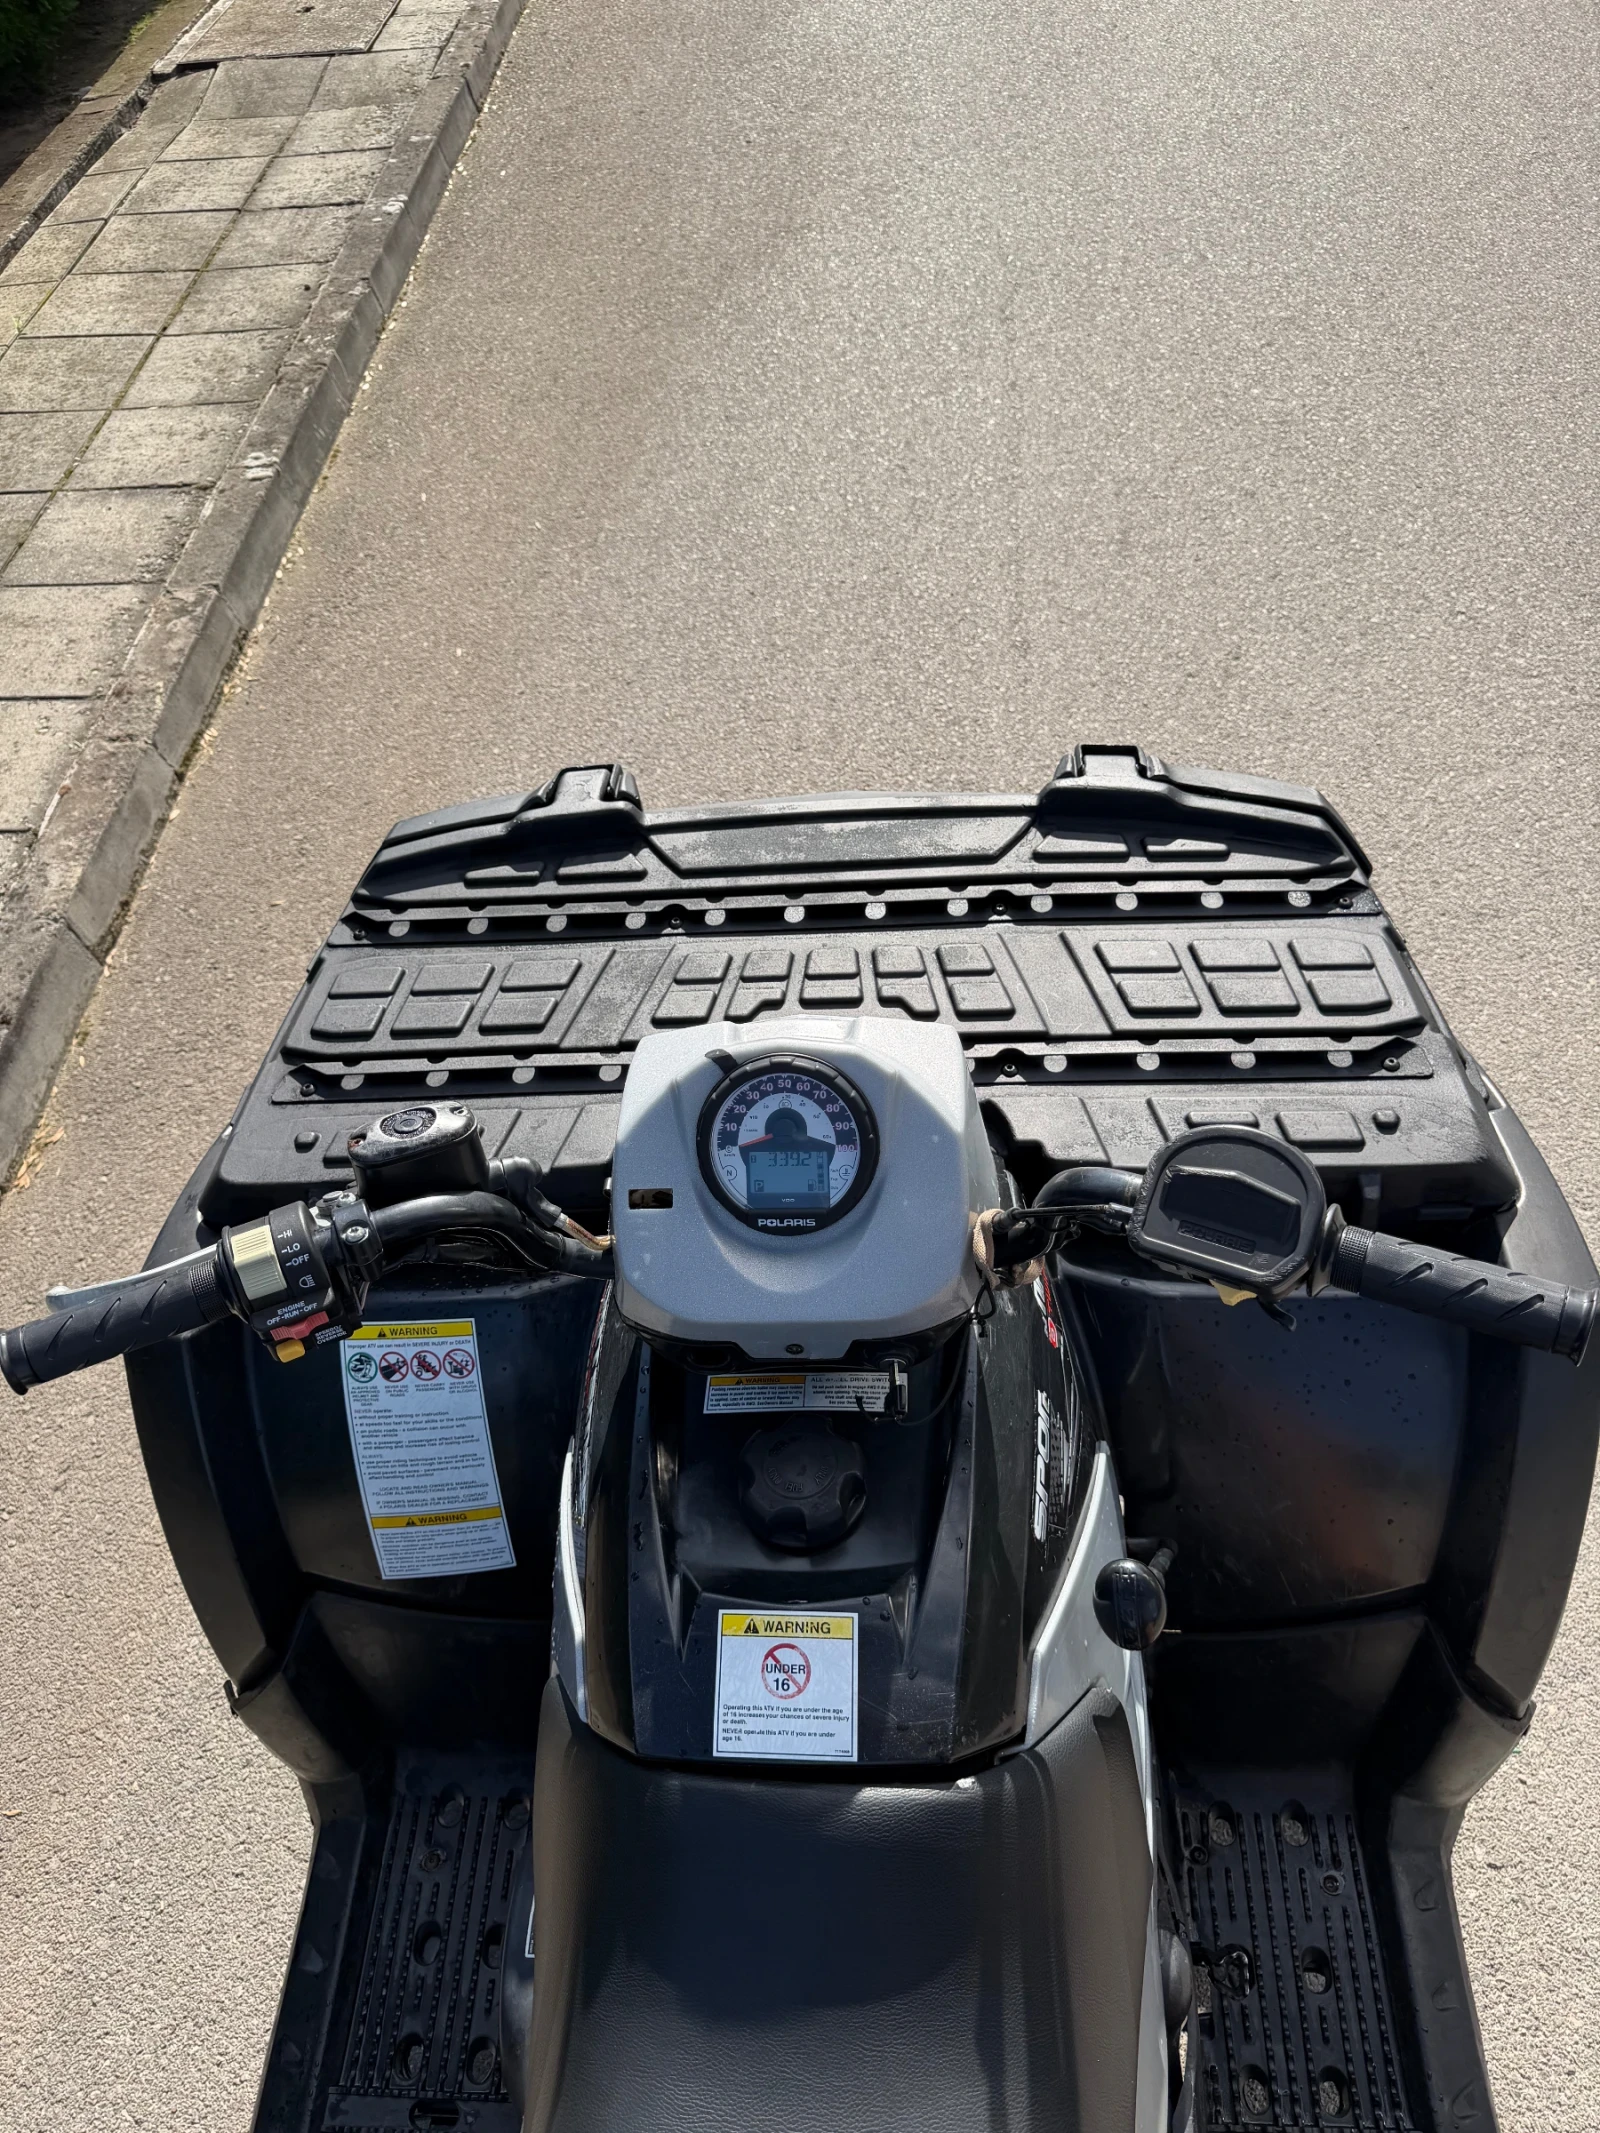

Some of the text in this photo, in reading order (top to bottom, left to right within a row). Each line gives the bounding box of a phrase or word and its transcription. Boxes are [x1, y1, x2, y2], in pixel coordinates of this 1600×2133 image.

[760, 1083, 773, 1091] 40
[778, 1080, 791, 1088] 50
[746, 1091, 759, 1100] 30
[813, 1091, 826, 1099] 70
[826, 1104, 839, 1112] 80
[277, 1301, 305, 1315] ENGINE
[389, 1327, 438, 1336] WARNING
[418, 1513, 467, 1524] WARNING
[763, 1620, 831, 1634] WARNING
[766, 1664, 806, 1674] UNDER
[774, 1678, 790, 1691] 16
